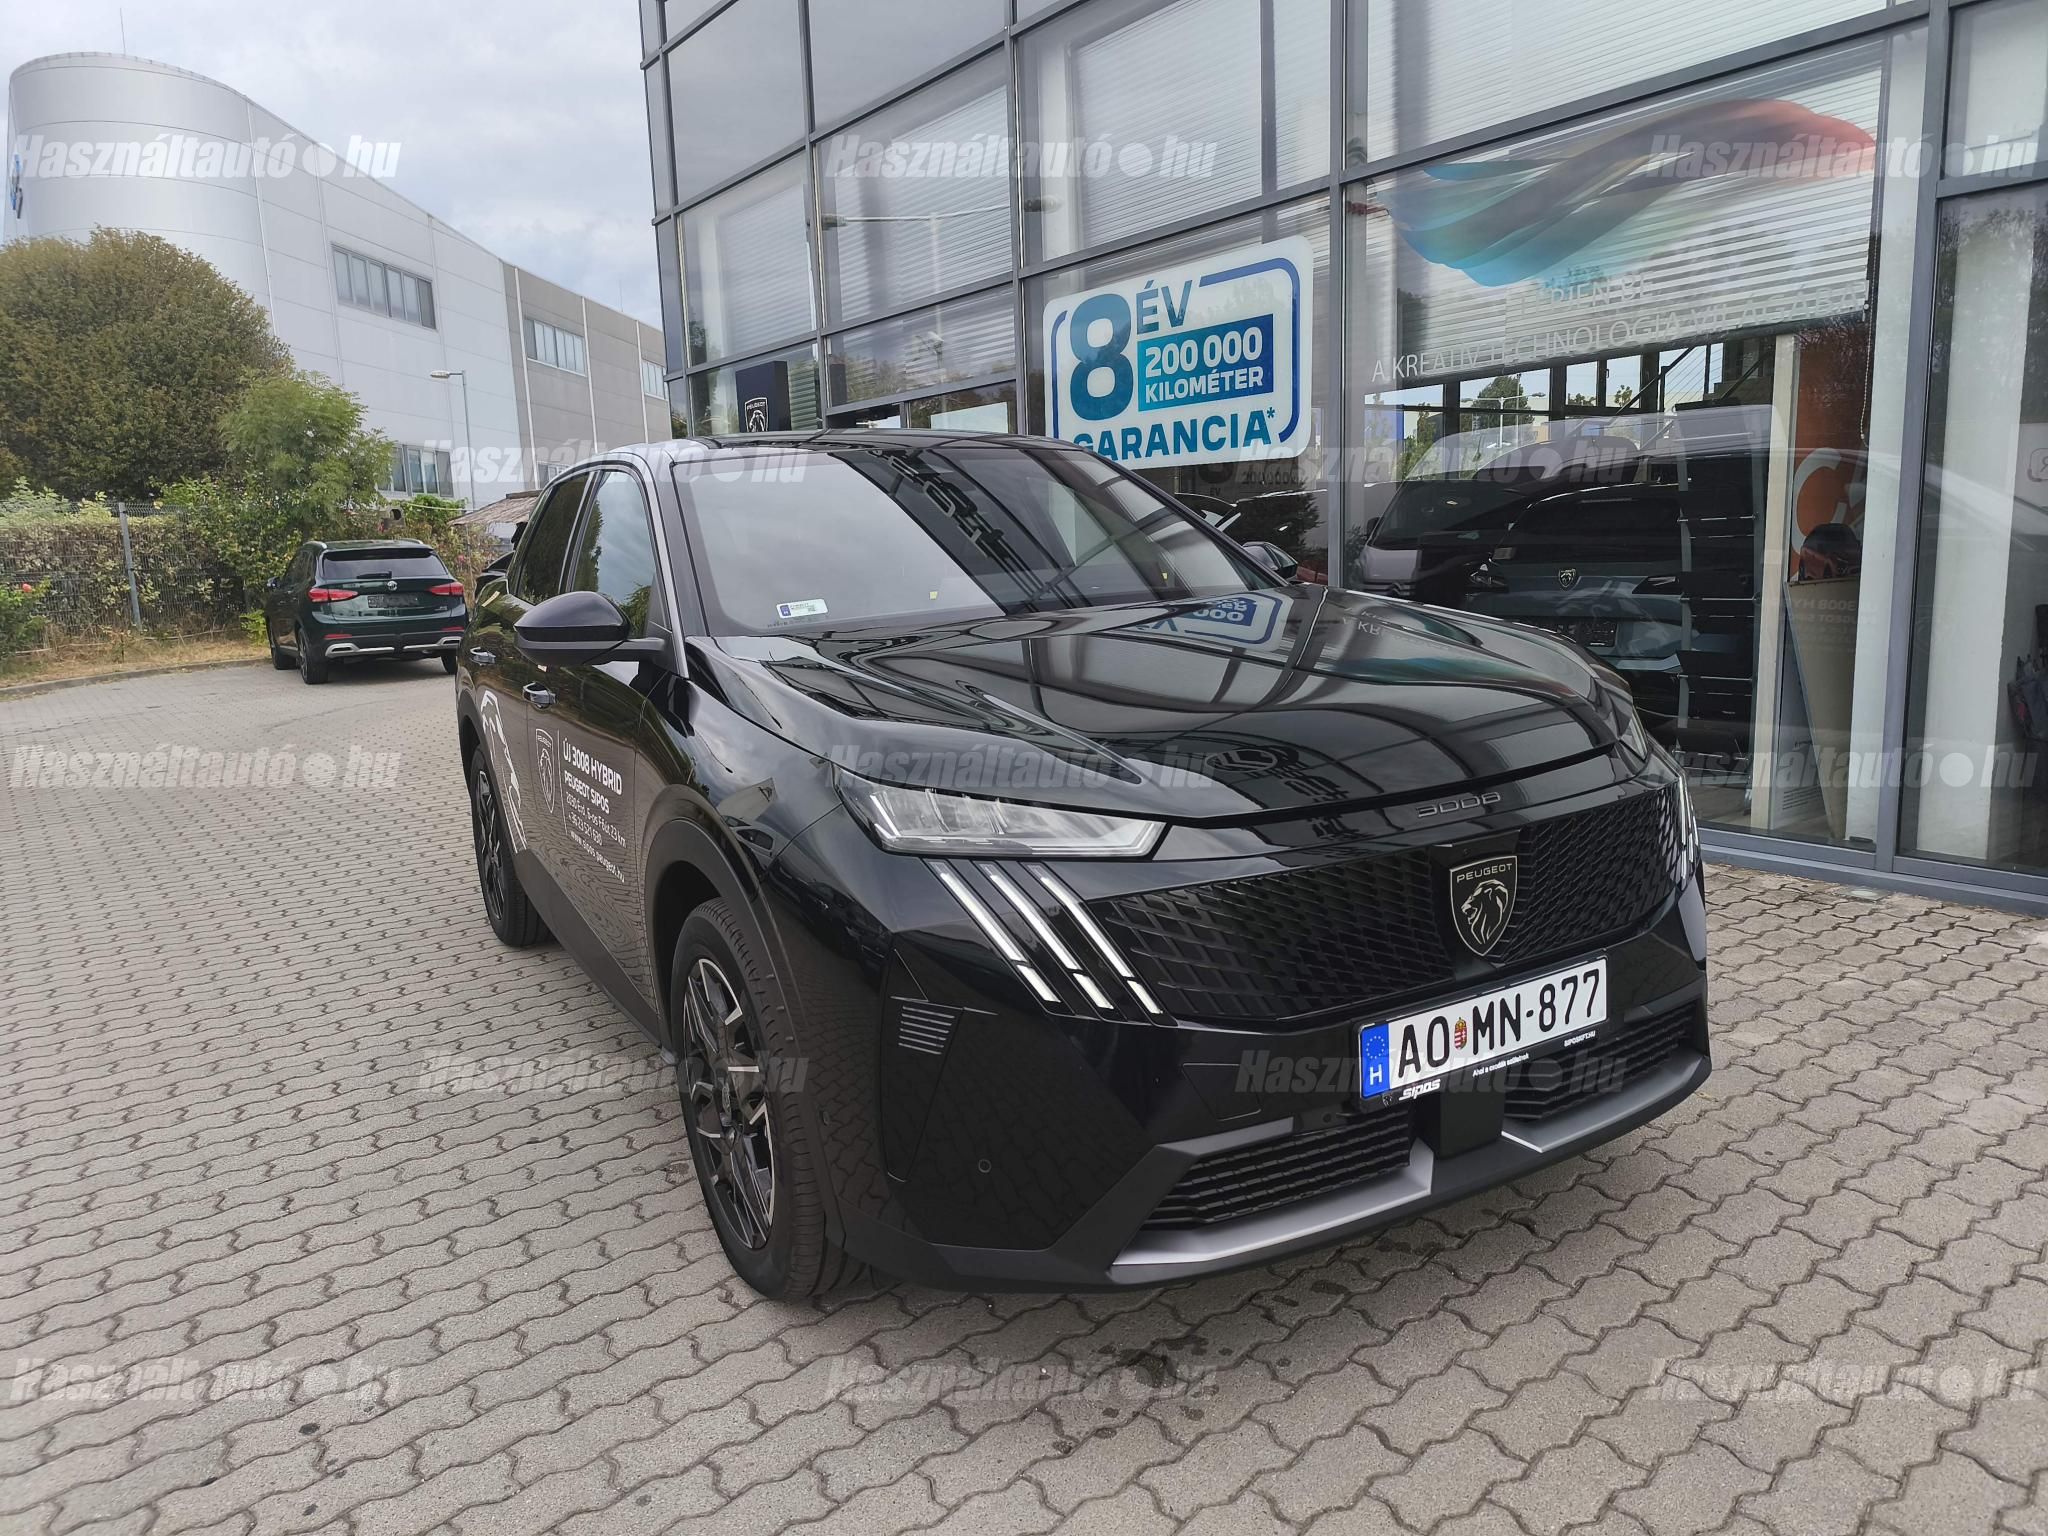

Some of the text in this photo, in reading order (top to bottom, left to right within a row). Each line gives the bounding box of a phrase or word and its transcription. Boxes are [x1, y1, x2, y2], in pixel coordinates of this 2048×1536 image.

[1070, 279, 1193, 421] 8 ÉV
[1145, 326, 1264, 378] 200 000
[1145, 366, 1264, 404] KILOMÉTER
[564, 770, 610, 814] PEUGEOT SIPOS
[572, 746, 590, 775] 3008
[591, 757, 622, 795] HYBRID
[1418, 791, 1501, 818] 3008
[1456, 863, 1513, 883] PEUGEOT
[1398, 968, 1600, 1078] AO MN-877
[1369, 1063, 1383, 1086] H
